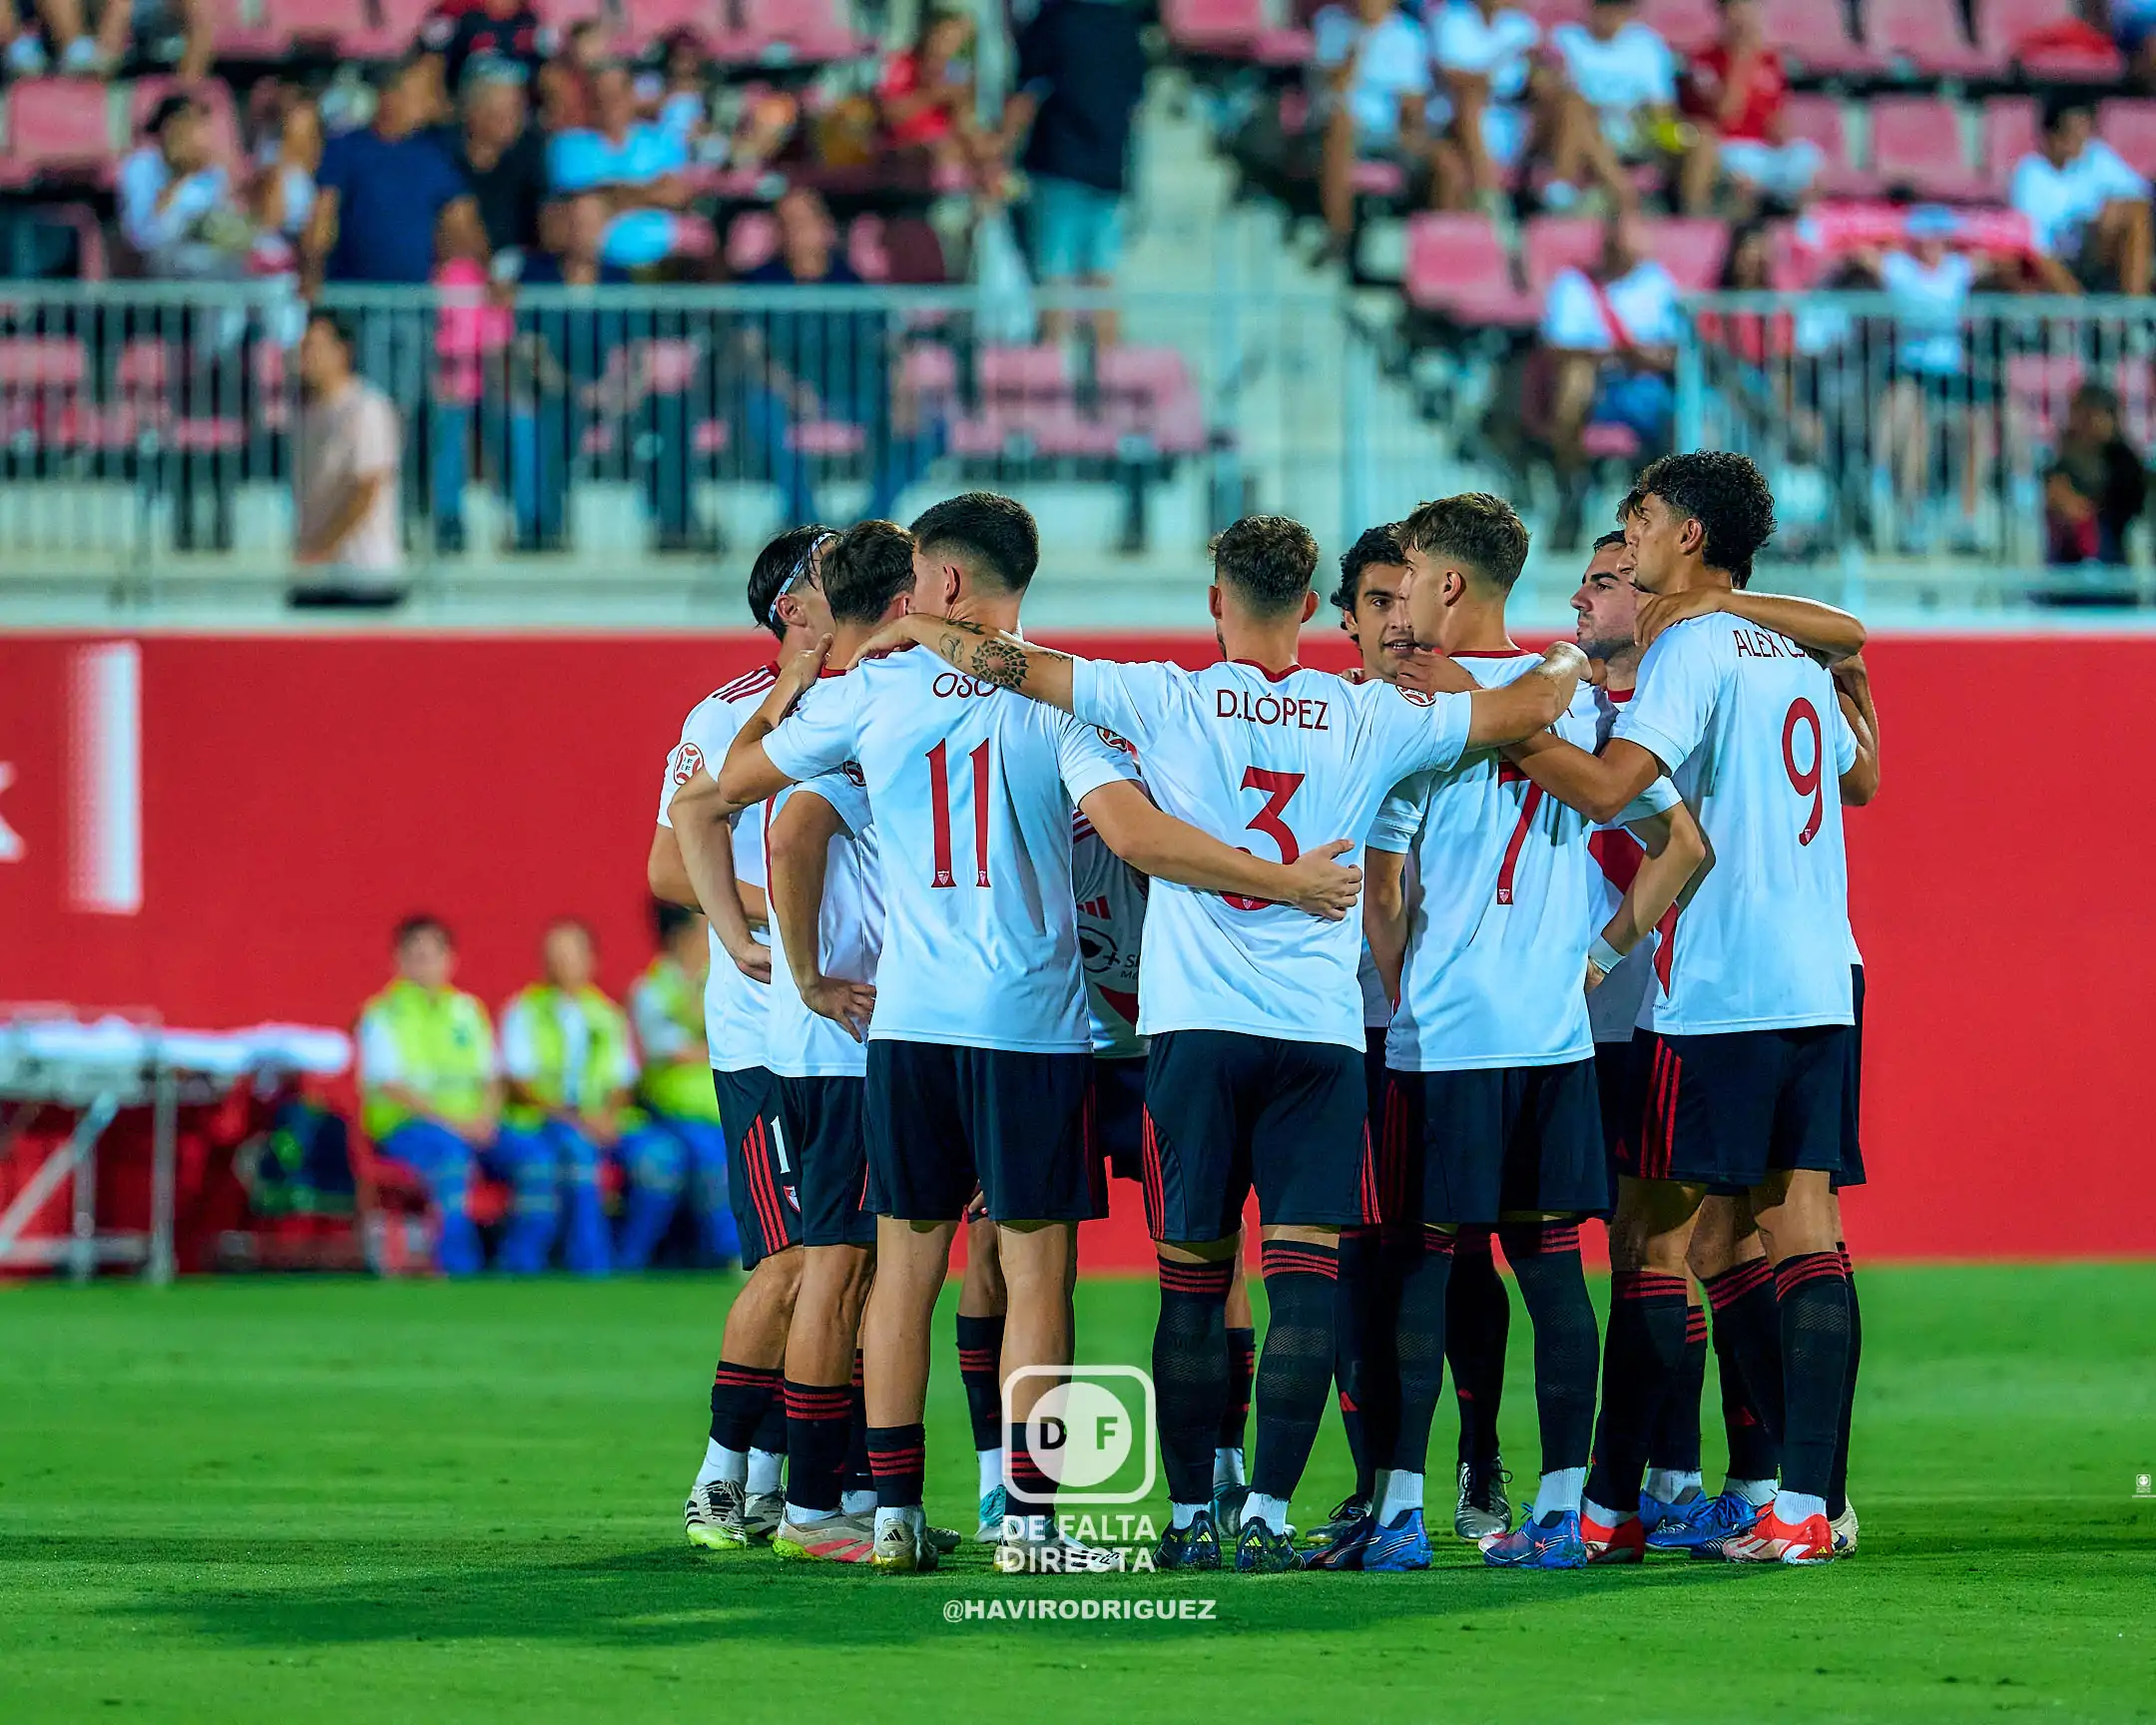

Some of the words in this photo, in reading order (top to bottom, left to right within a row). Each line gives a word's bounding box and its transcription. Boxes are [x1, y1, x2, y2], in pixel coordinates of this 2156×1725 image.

[932, 672, 999, 698] OSO
[1215, 689, 1330, 731] D.LÓPEZ
[1732, 629, 1785, 658] ALEX
[925, 737, 991, 888] 11
[1219, 765, 1306, 911] 3
[1497, 761, 1545, 905] 7
[1782, 697, 1823, 847] 9
